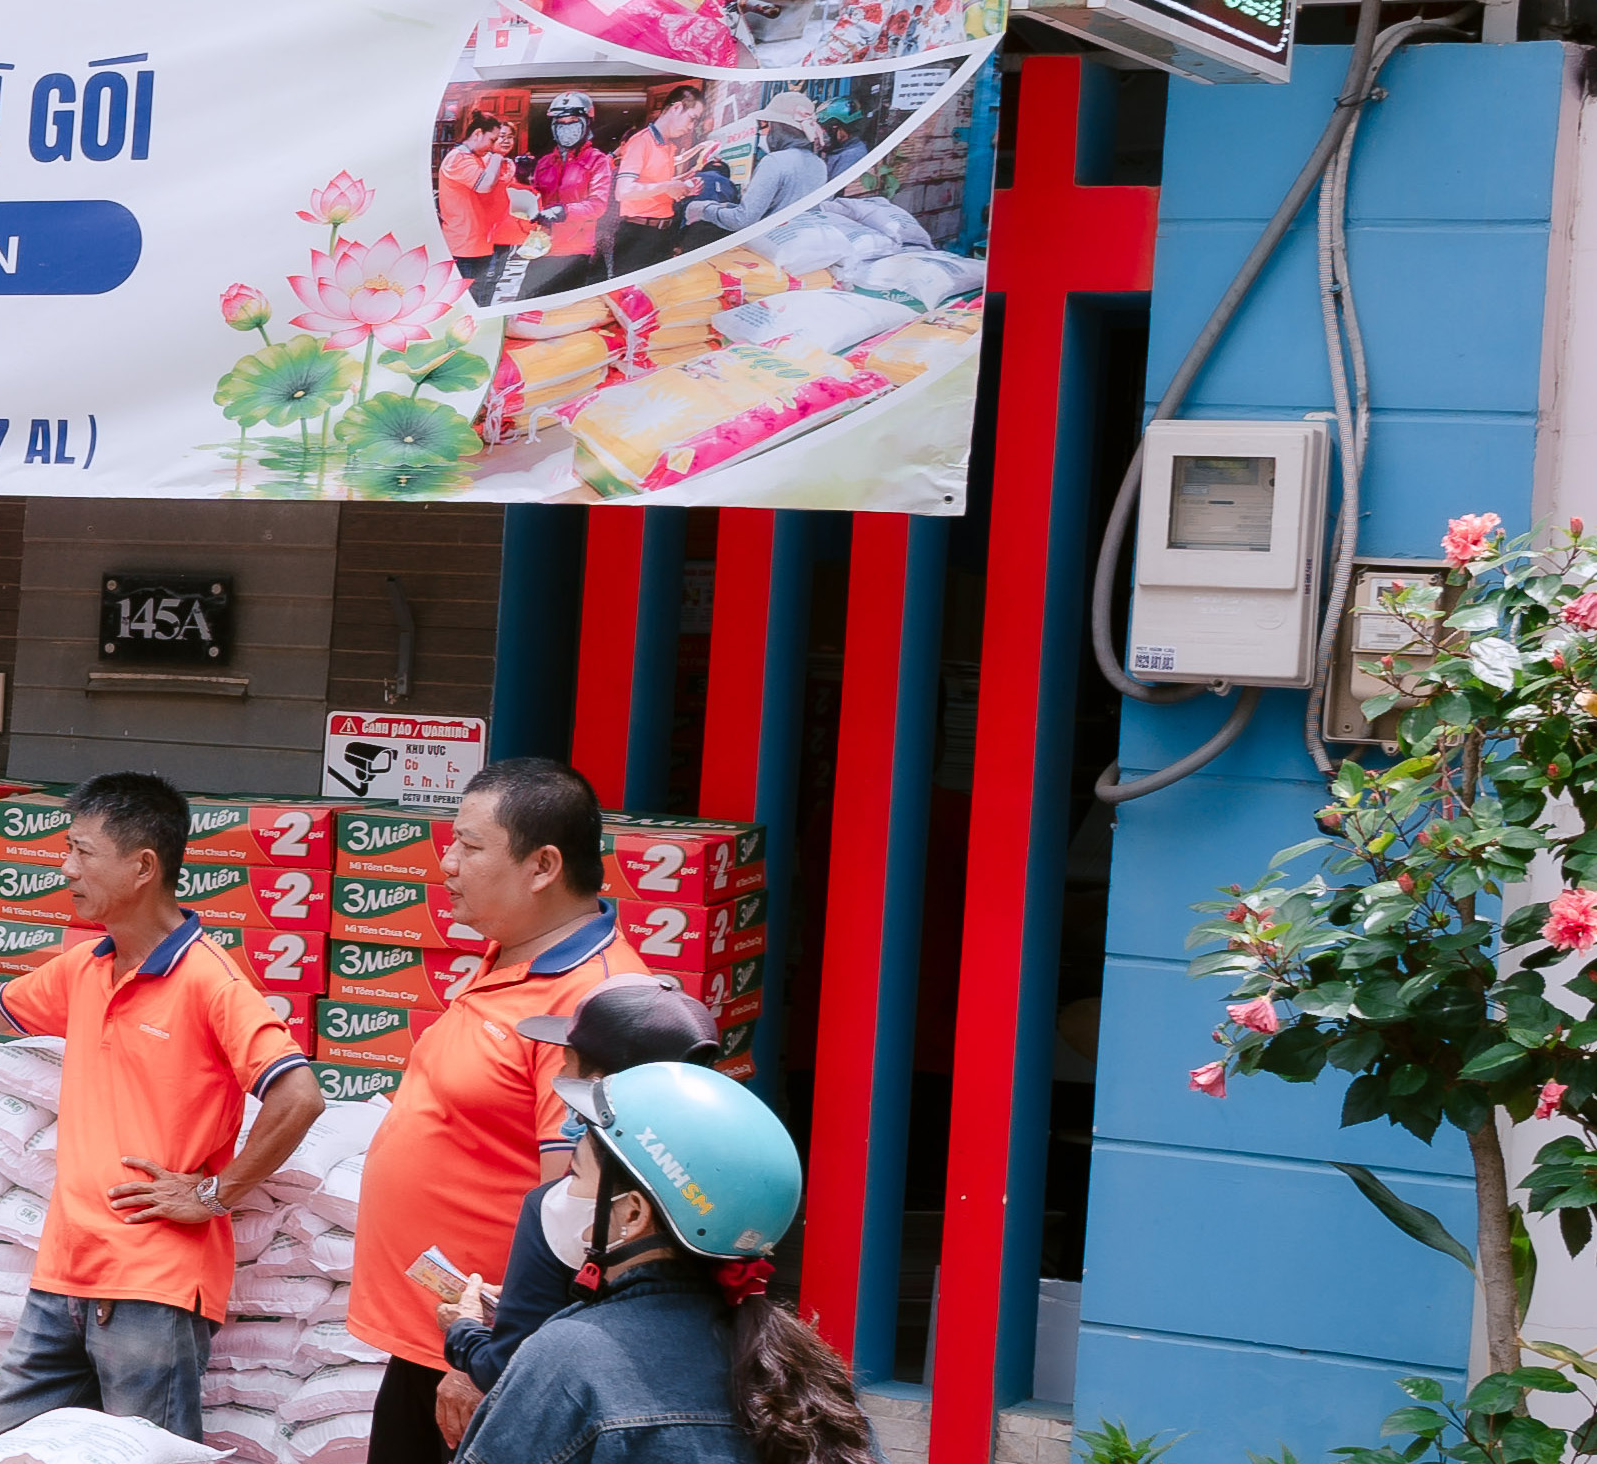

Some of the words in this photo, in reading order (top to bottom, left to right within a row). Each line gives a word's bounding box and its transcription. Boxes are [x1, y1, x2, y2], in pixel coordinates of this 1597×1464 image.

[29, 54, 153, 162] GÓI
[27, 416, 96, 468] AL)
[116, 597, 212, 641] 145A
[635, 1126, 690, 1188] XANH
